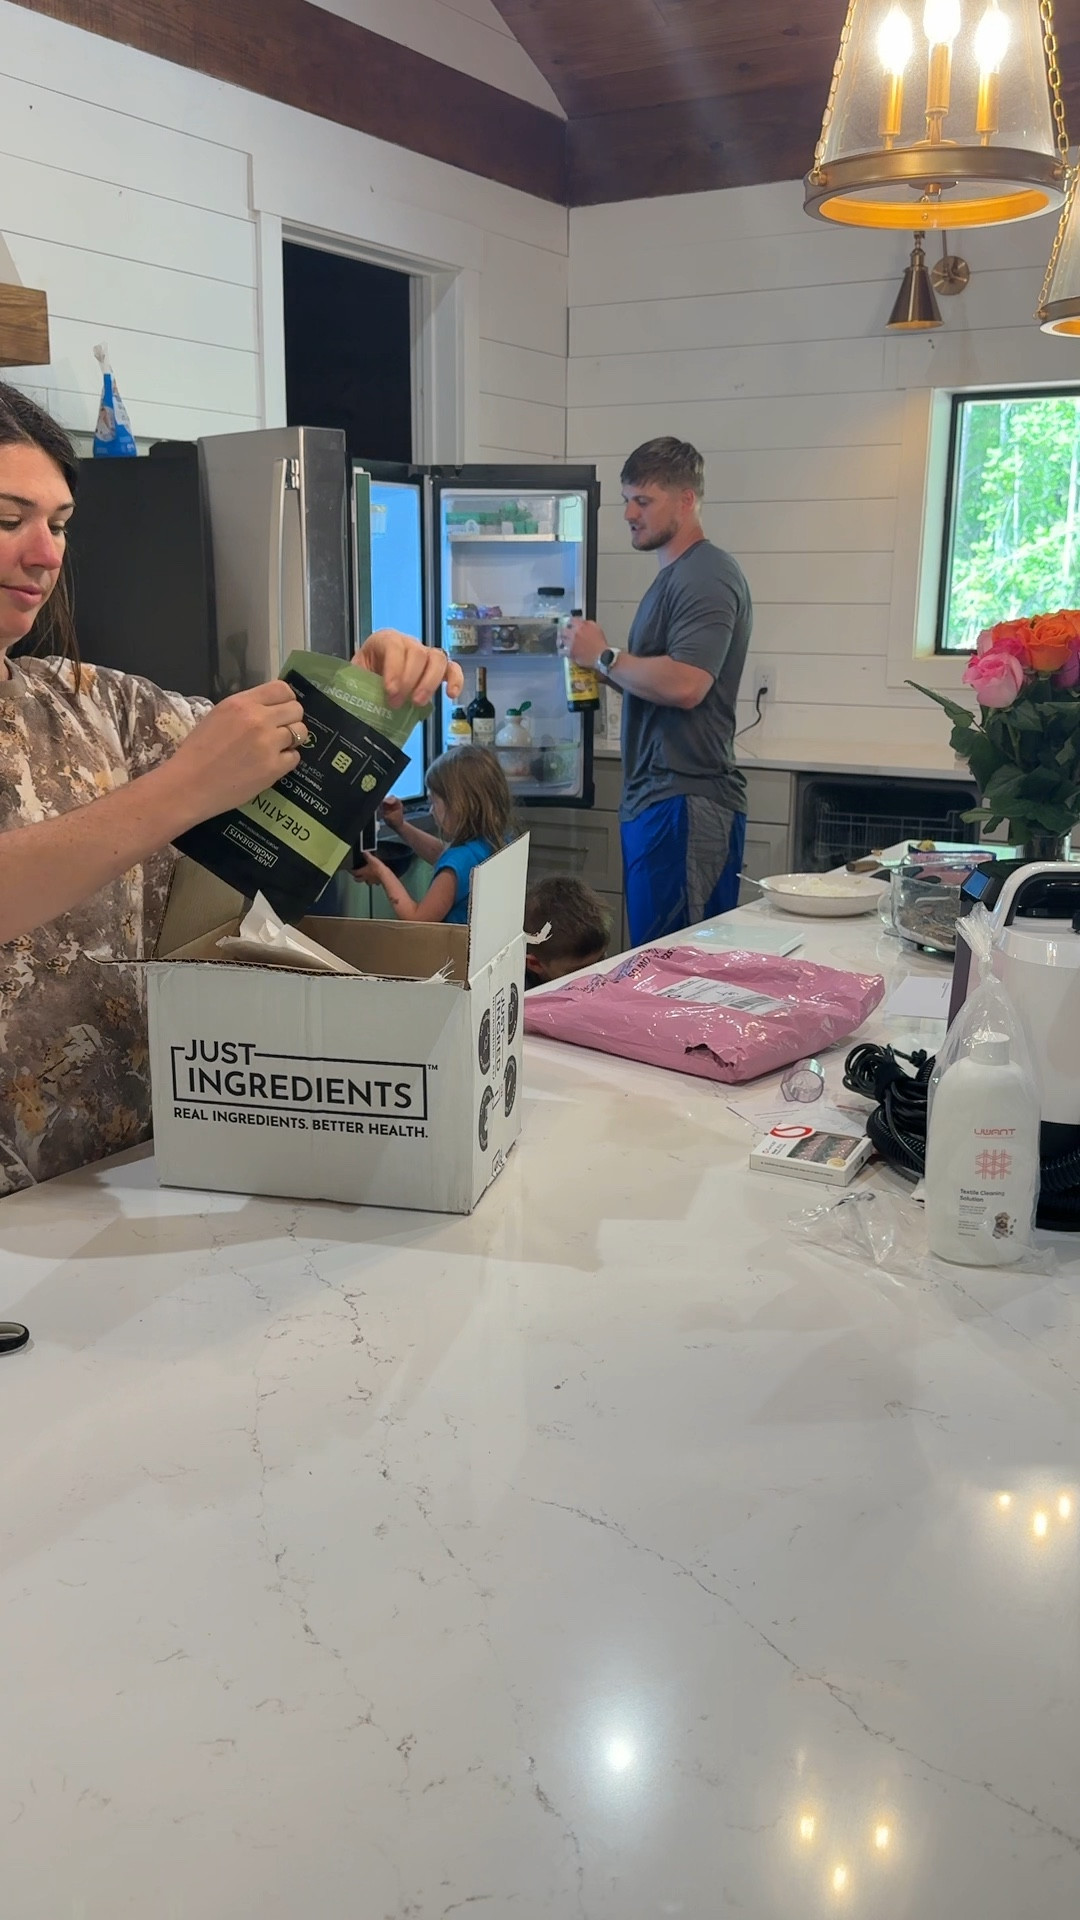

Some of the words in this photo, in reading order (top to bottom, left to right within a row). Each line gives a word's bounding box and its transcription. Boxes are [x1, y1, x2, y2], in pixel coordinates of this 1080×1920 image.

[293, 785, 329, 815] CREATINE
[228, 827, 274, 861] INGREDIENTS
[254, 854, 269, 867] JUST
[184, 1039, 256, 1065] JUST
[188, 1068, 412, 1109] INGREDIENTS
[174, 1107, 208, 1122] REAL
[212, 1111, 309, 1130] INGREDIENTS.
[312, 1119, 364, 1134] BETTER
[369, 1124, 428, 1138] HEALTH.
[960, 1188, 978, 1196] Textile
